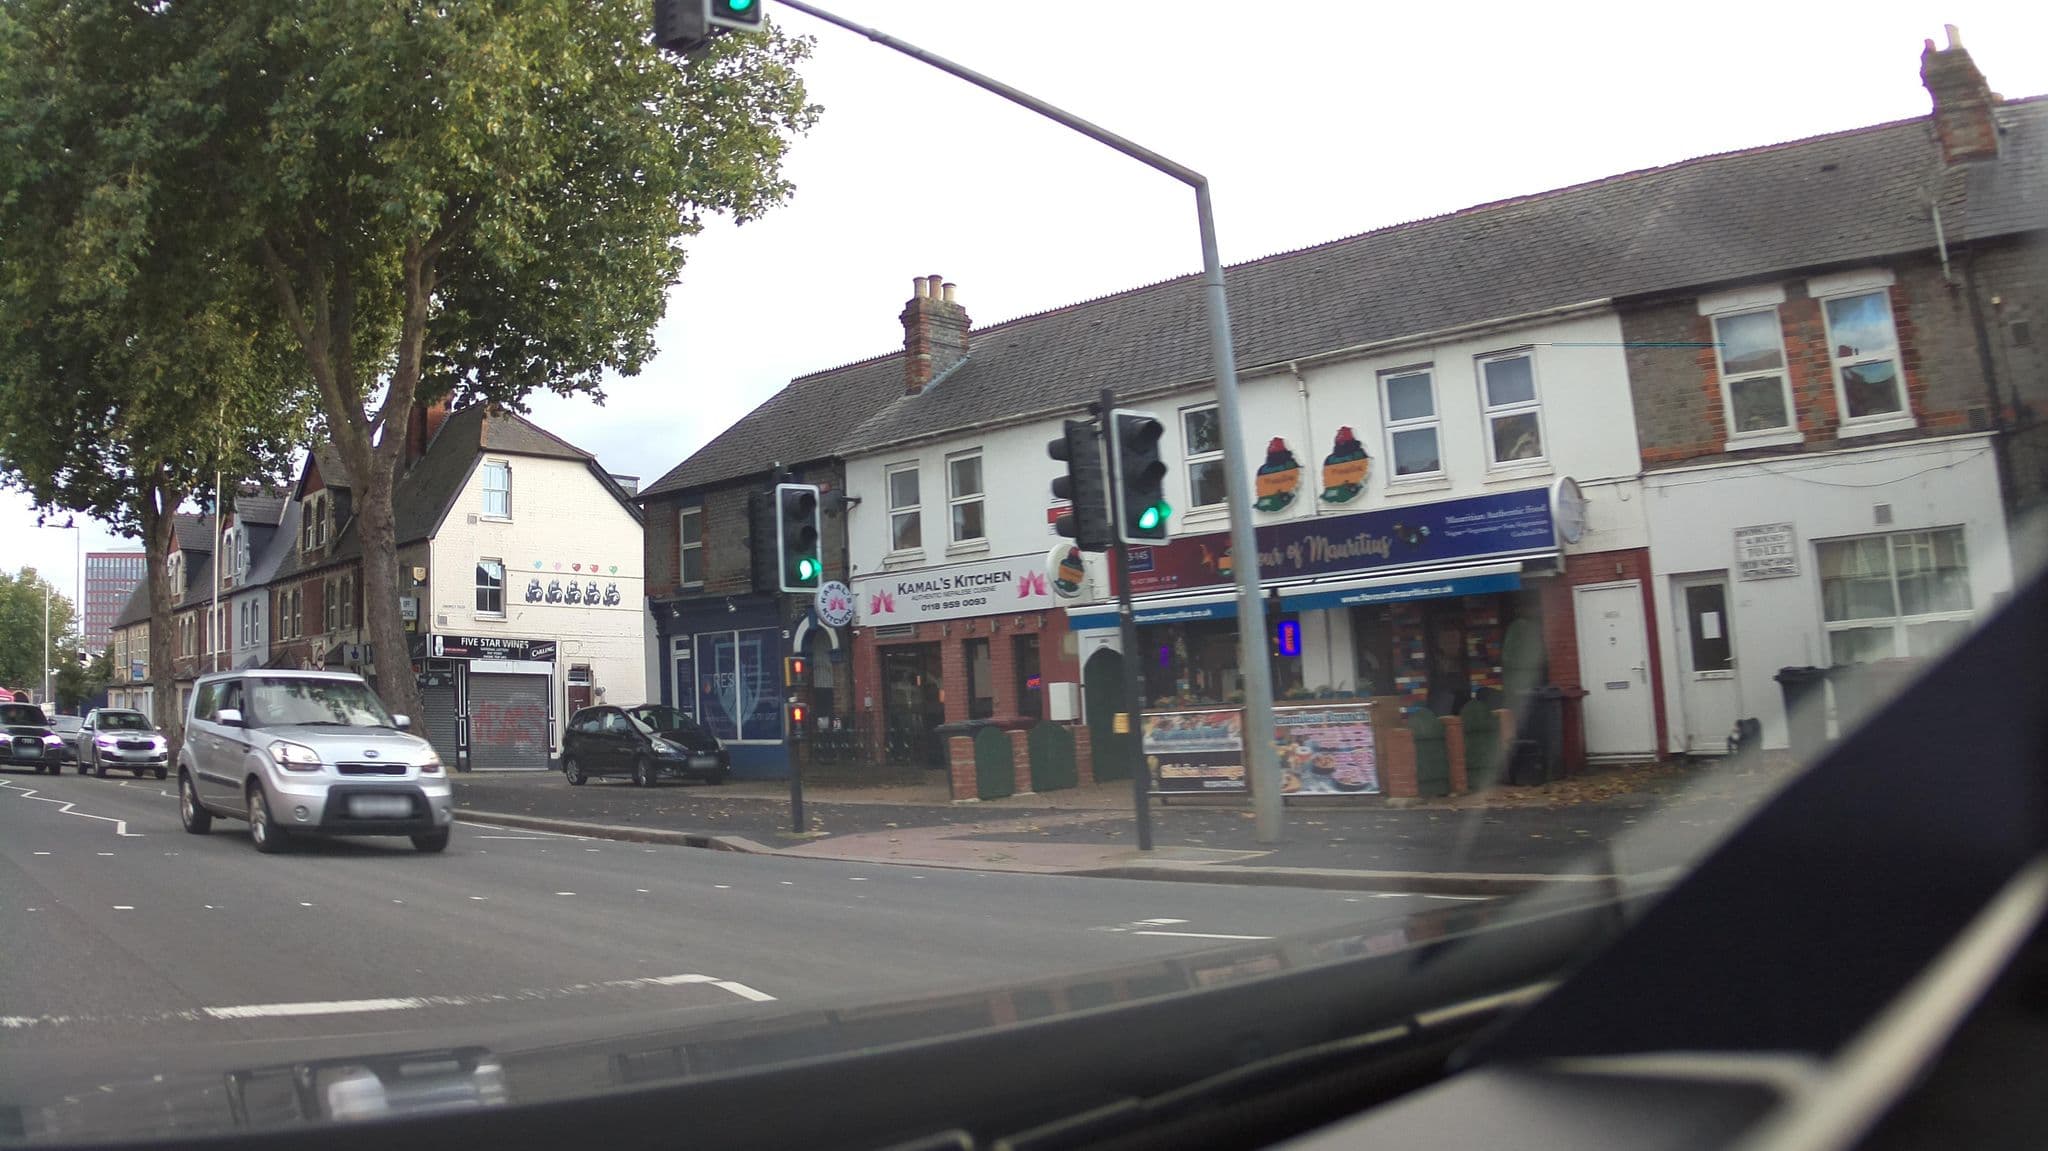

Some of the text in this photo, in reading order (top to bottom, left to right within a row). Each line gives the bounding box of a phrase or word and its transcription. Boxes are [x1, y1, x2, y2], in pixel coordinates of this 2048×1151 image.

[1303, 532, 1393, 563] Mauritius
[898, 570, 1012, 595] KAMAL'S KITCHEN
[911, 585, 997, 601] AUTHENTIC NEPALESE CUISINE
[921, 598, 987, 612] 0118 959 0093
[822, 607, 852, 624] KITCHEN
[460, 637, 529, 649] FIVE STAR WINES
